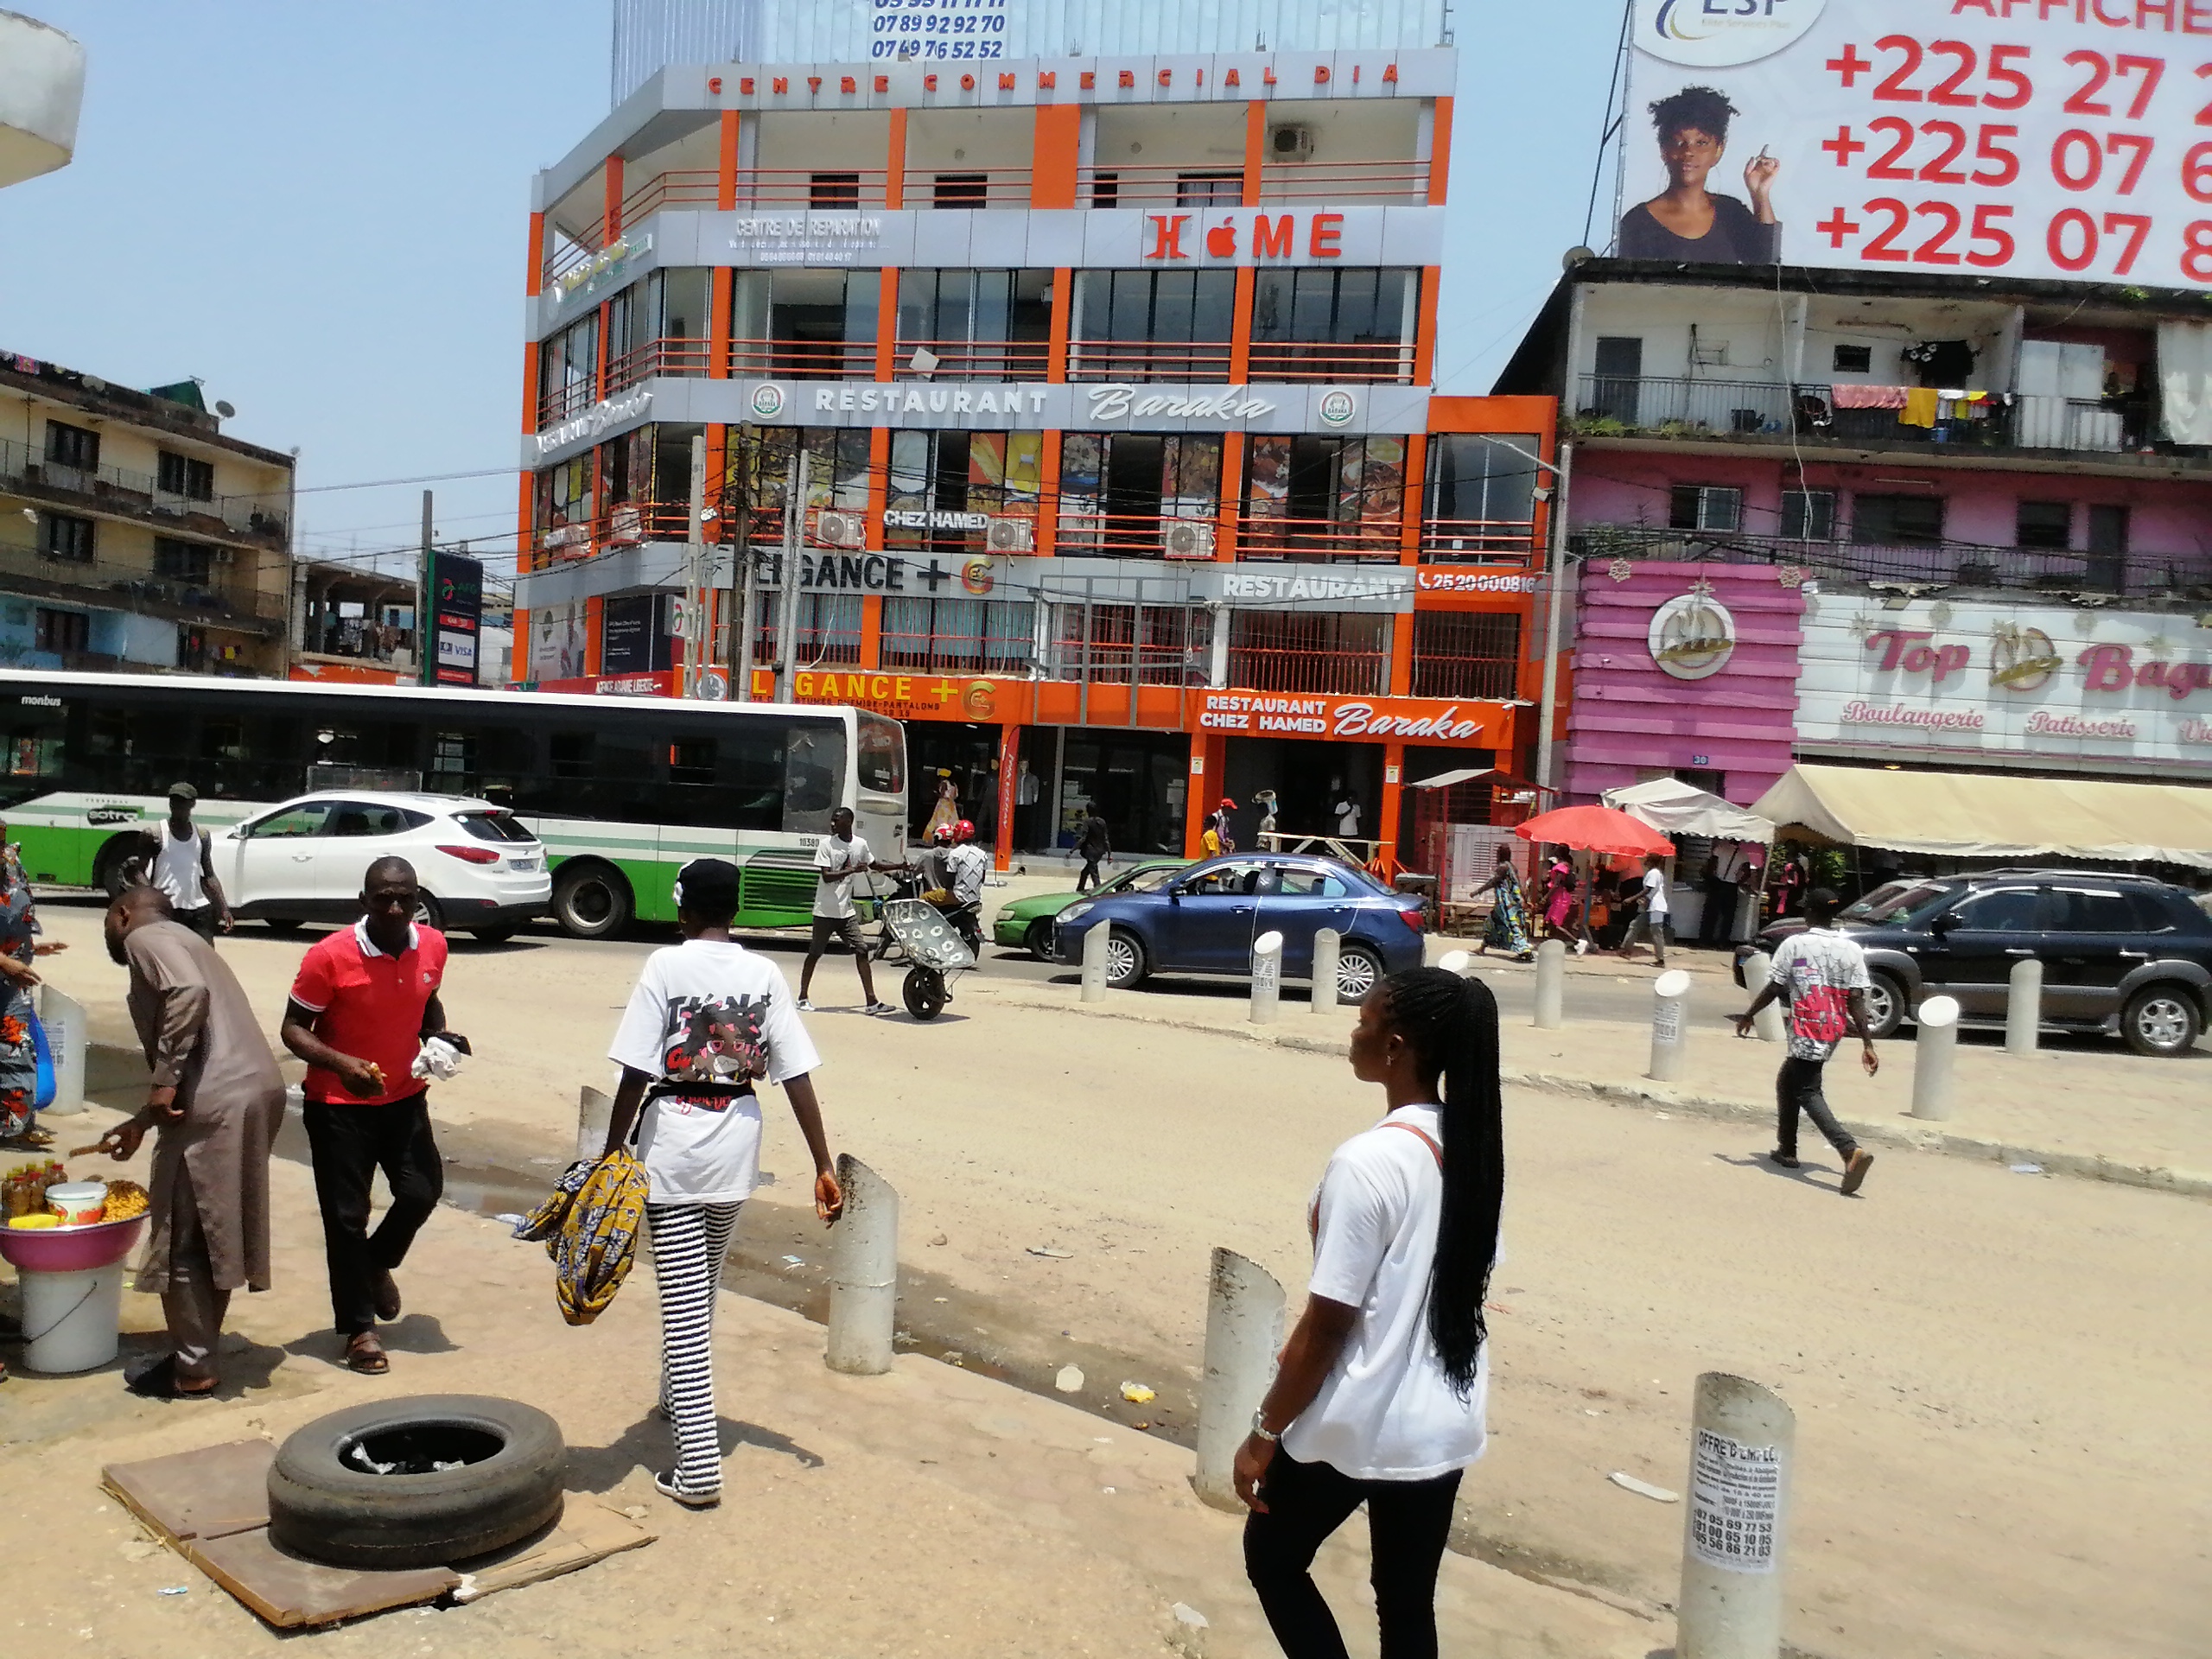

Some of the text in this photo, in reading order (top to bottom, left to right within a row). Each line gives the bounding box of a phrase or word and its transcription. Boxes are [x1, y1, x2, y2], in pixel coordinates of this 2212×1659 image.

[874, 15, 898, 33] 07
[925, 15, 950, 34] 92
[954, 16, 977, 33] 92
[982, 15, 1005, 33] 70
[872, 41, 896, 57] 07
[951, 41, 975, 59] 52
[978, 41, 1002, 58] 52
[708, 64, 1399, 95] CENTRE COMMERCIAL DIA
[1827, 35, 2033, 110] +225
[2063, 49, 2165, 119] 27
[1821, 117, 2019, 187] +225
[2050, 129, 2155, 195] 07
[737, 218, 782, 237] CENTRE
[787, 218, 804, 237] DE
[1816, 197, 2015, 267] +225
[2046, 207, 2152, 276] 07
[815, 383, 1277, 423] RESTAURANT Baraka
[883, 510, 988, 530] CHEZ HAMED
[1223, 573, 1408, 601] RESTAURANT
[454, 645, 473, 657] VISA
[1866, 630, 1970, 682] Top
[753, 671, 912, 701] LGANCE
[21, 694, 61, 707] monbus
[1206, 695, 1328, 715] RESTAURANT
[1199, 713, 1327, 734] CHEZ HAMED
[1333, 702, 1485, 740] Baraka
[1843, 701, 1984, 732] Boulangerie
[2028, 711, 2138, 738] Patisserie
[1699, 1431, 1726, 1456] OFFRE
